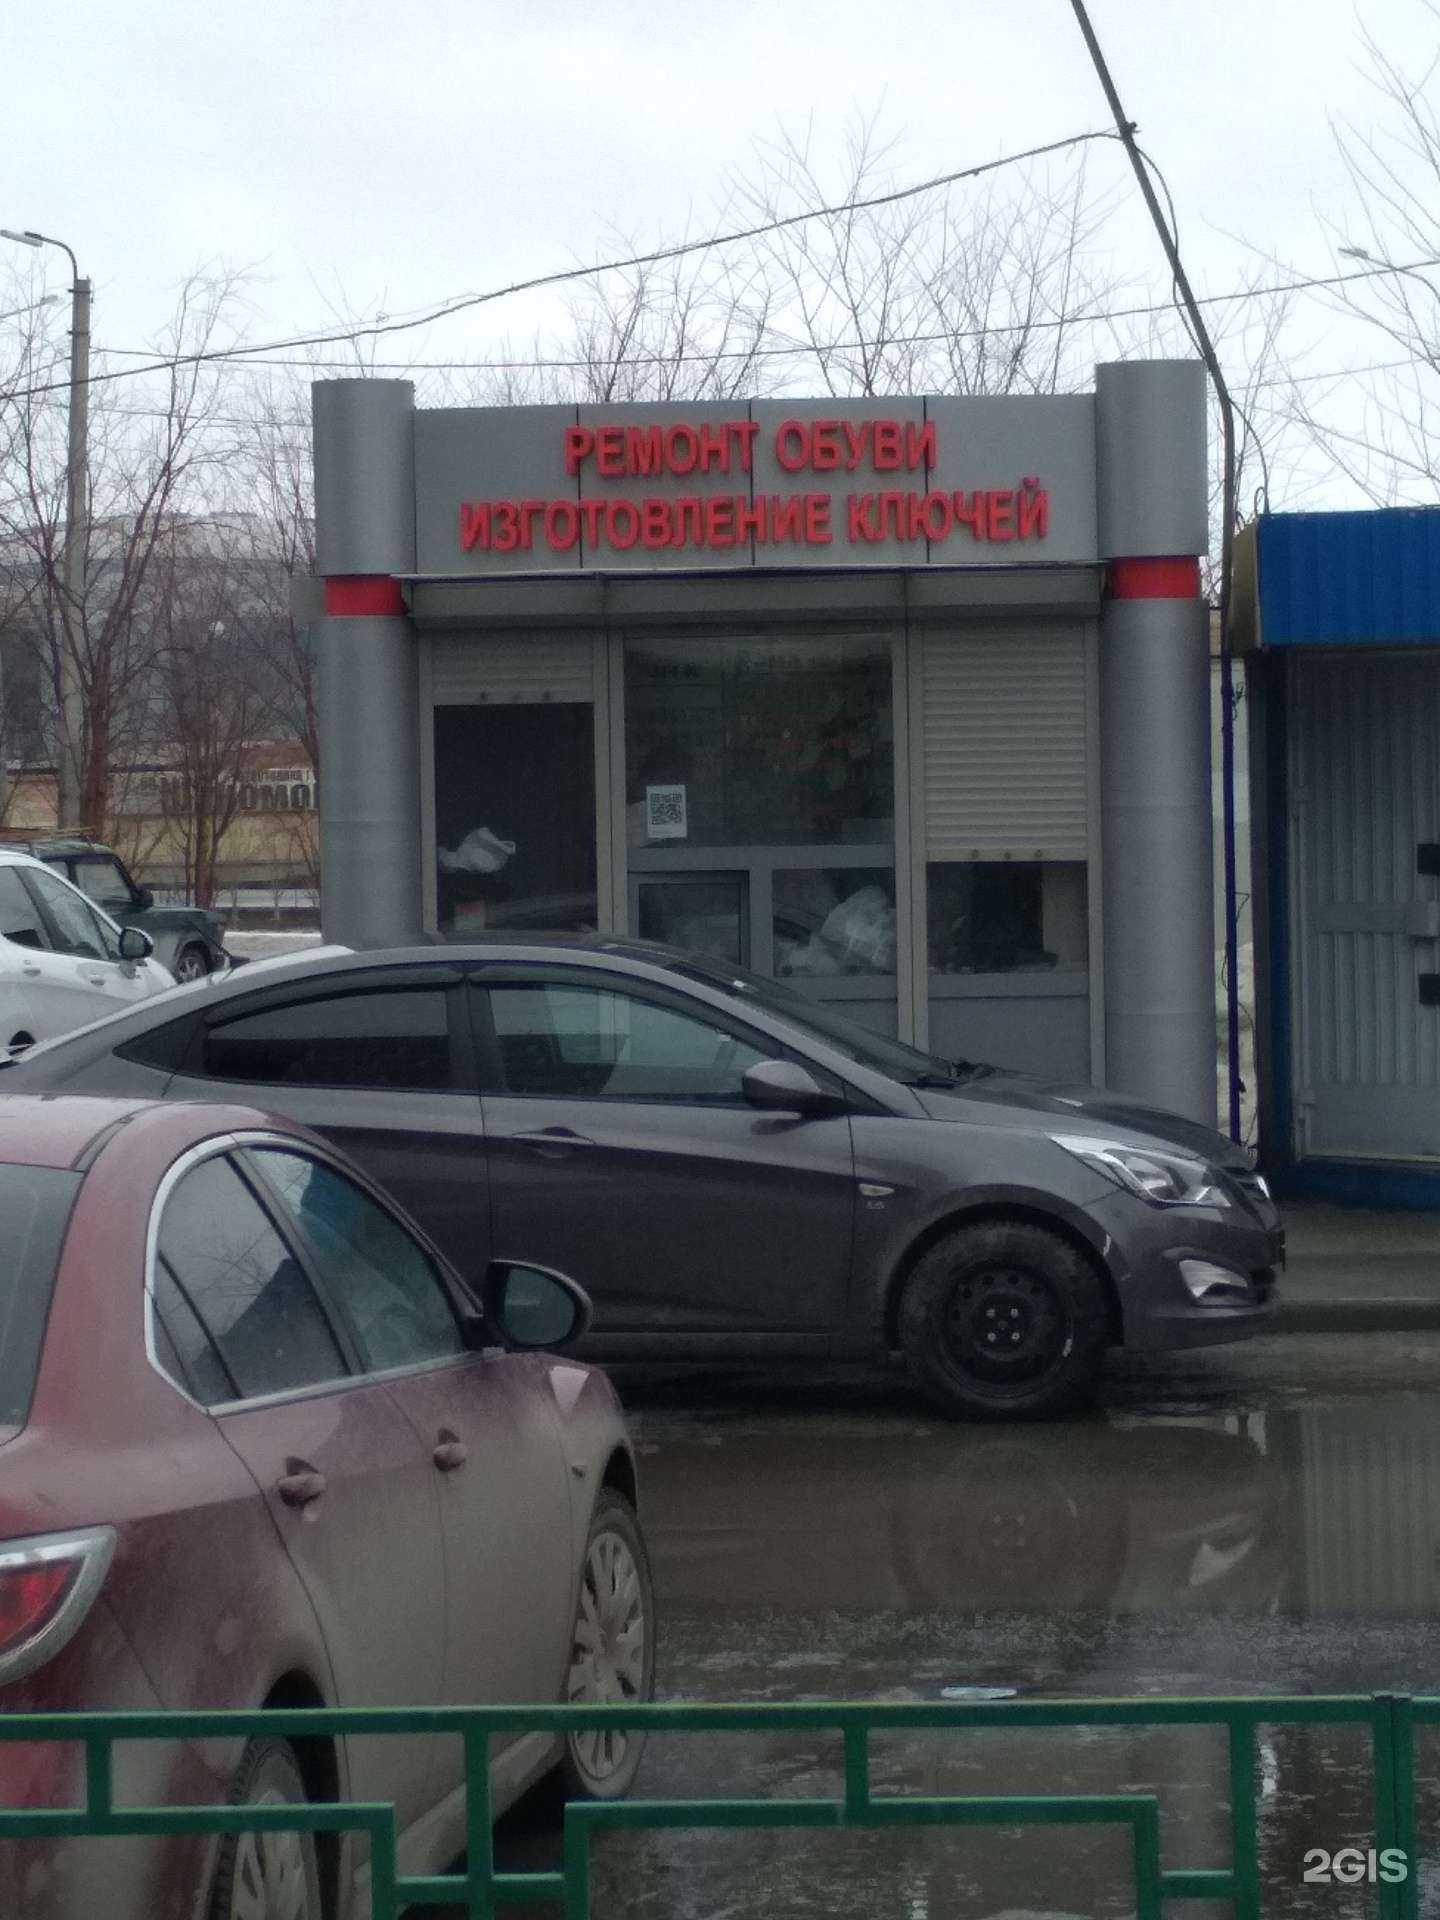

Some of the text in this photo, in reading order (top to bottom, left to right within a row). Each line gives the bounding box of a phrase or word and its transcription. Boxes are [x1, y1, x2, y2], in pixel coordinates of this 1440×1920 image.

[565, 418, 938, 476] РЕМОНТ ОБУВИ
[460, 477, 1050, 552] ИЗГОТОВЛЕНИЕ КЛЮЧЕЙ
